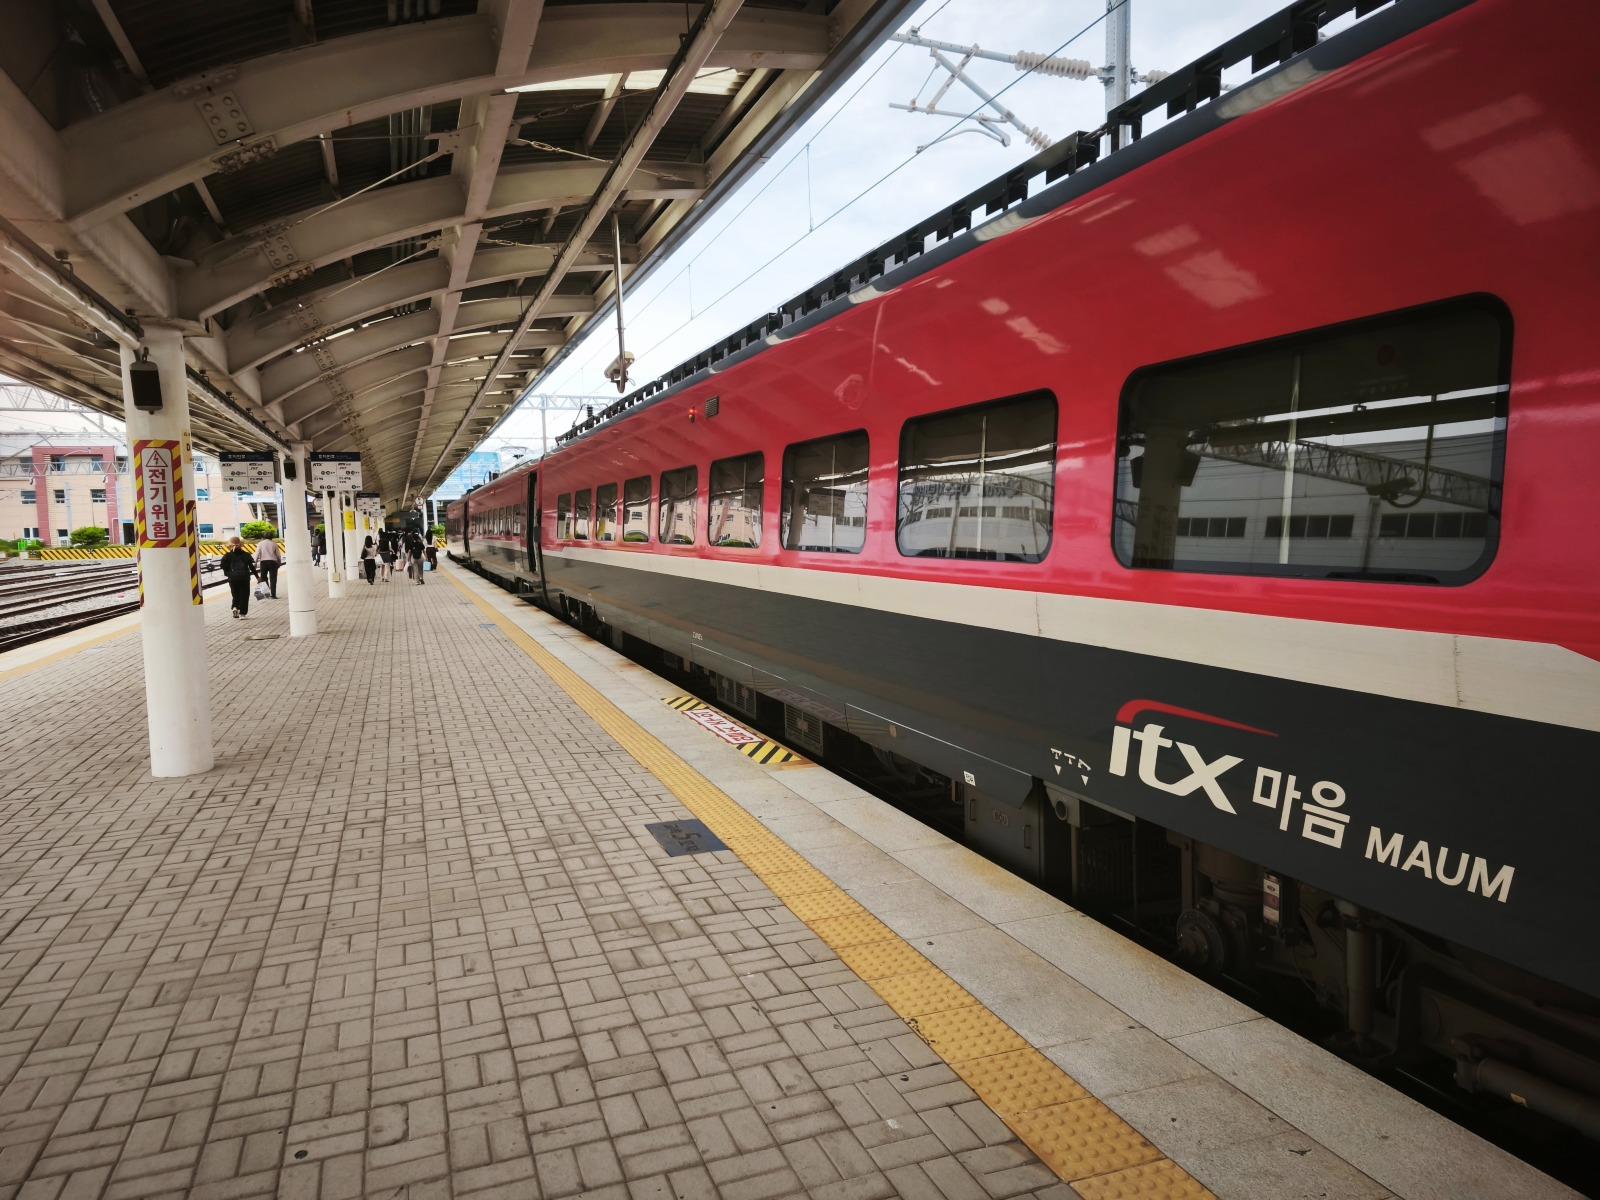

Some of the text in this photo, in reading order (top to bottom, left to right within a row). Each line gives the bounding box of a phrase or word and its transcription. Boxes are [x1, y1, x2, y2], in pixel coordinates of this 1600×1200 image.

[148, 468, 170, 539] 전기위험
[1252, 765, 1351, 849] 마음
[1364, 826, 1516, 904] MAUM
